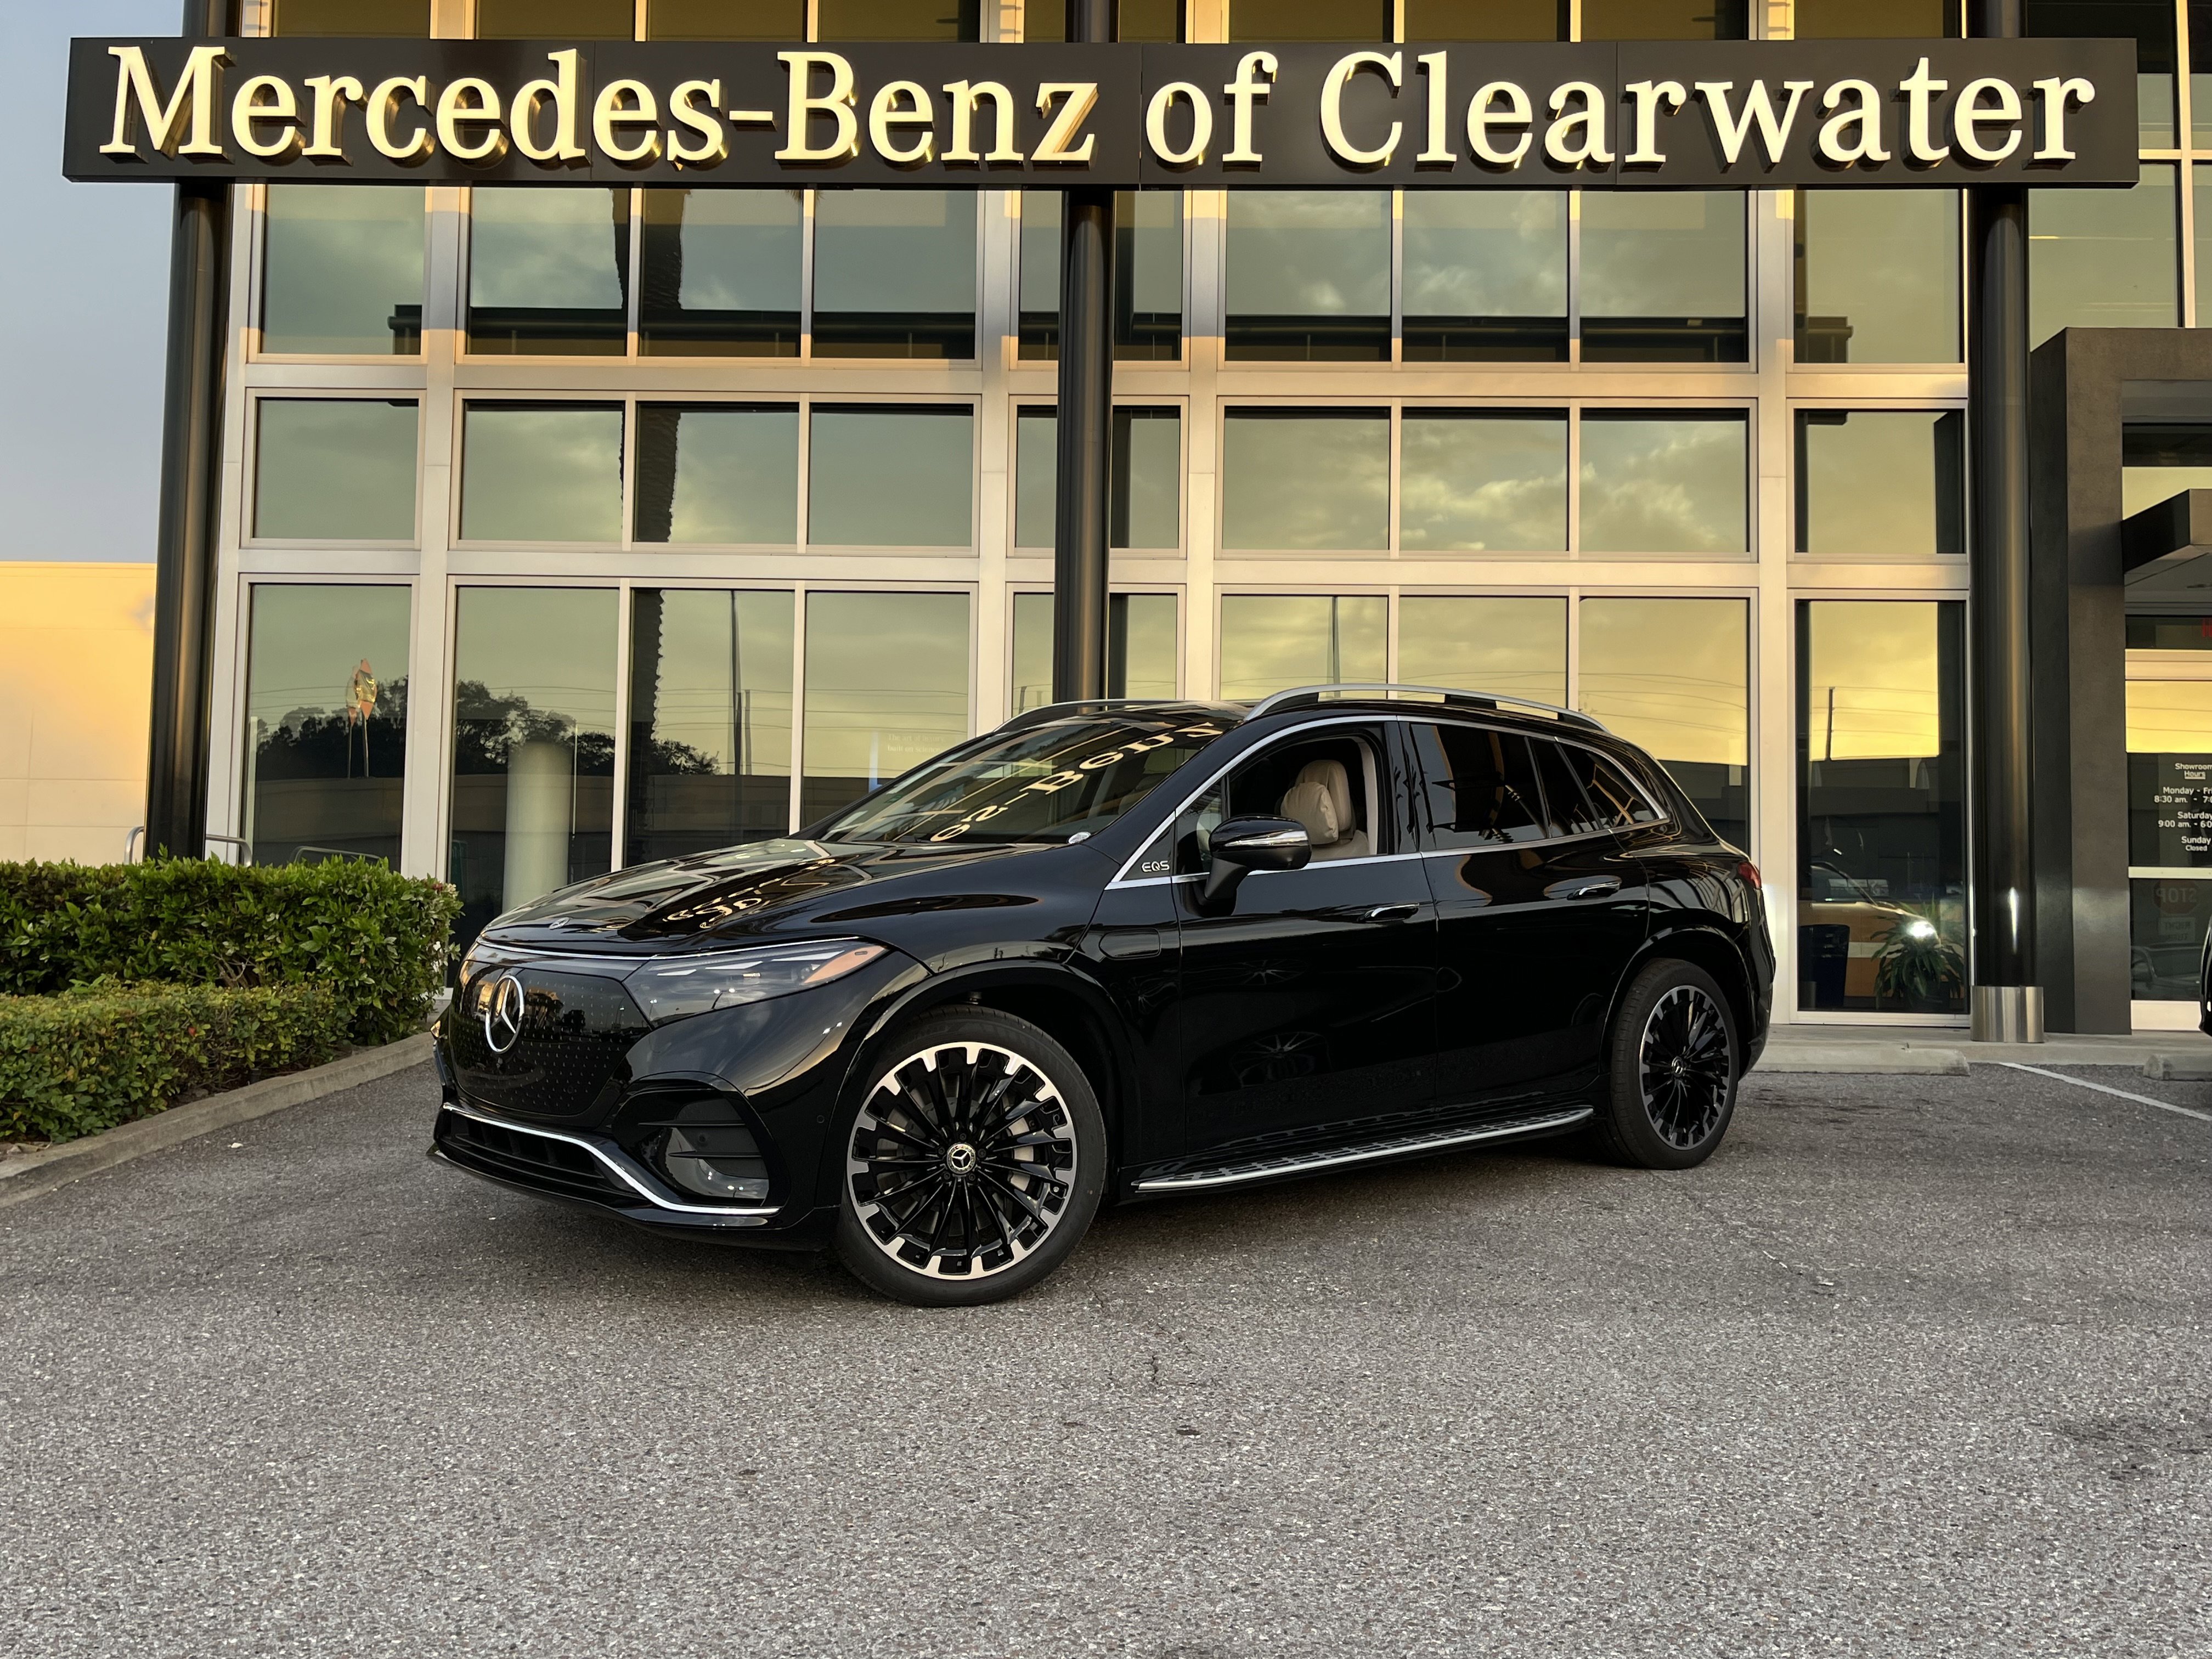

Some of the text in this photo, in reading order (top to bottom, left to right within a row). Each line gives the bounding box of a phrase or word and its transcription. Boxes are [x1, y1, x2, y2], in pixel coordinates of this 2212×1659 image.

[99, 46, 2096, 165] Mercedes-Benz of Clearwater
[2184, 770, 2205, 778] Hours
[2163, 786, 2194, 795] Monday
[2154, 795, 2172, 803] 8:30
[2177, 811, 2212, 821] Saturday
[2181, 836, 2211, 845] Sunday
[1142, 861, 1170, 872] EQS
